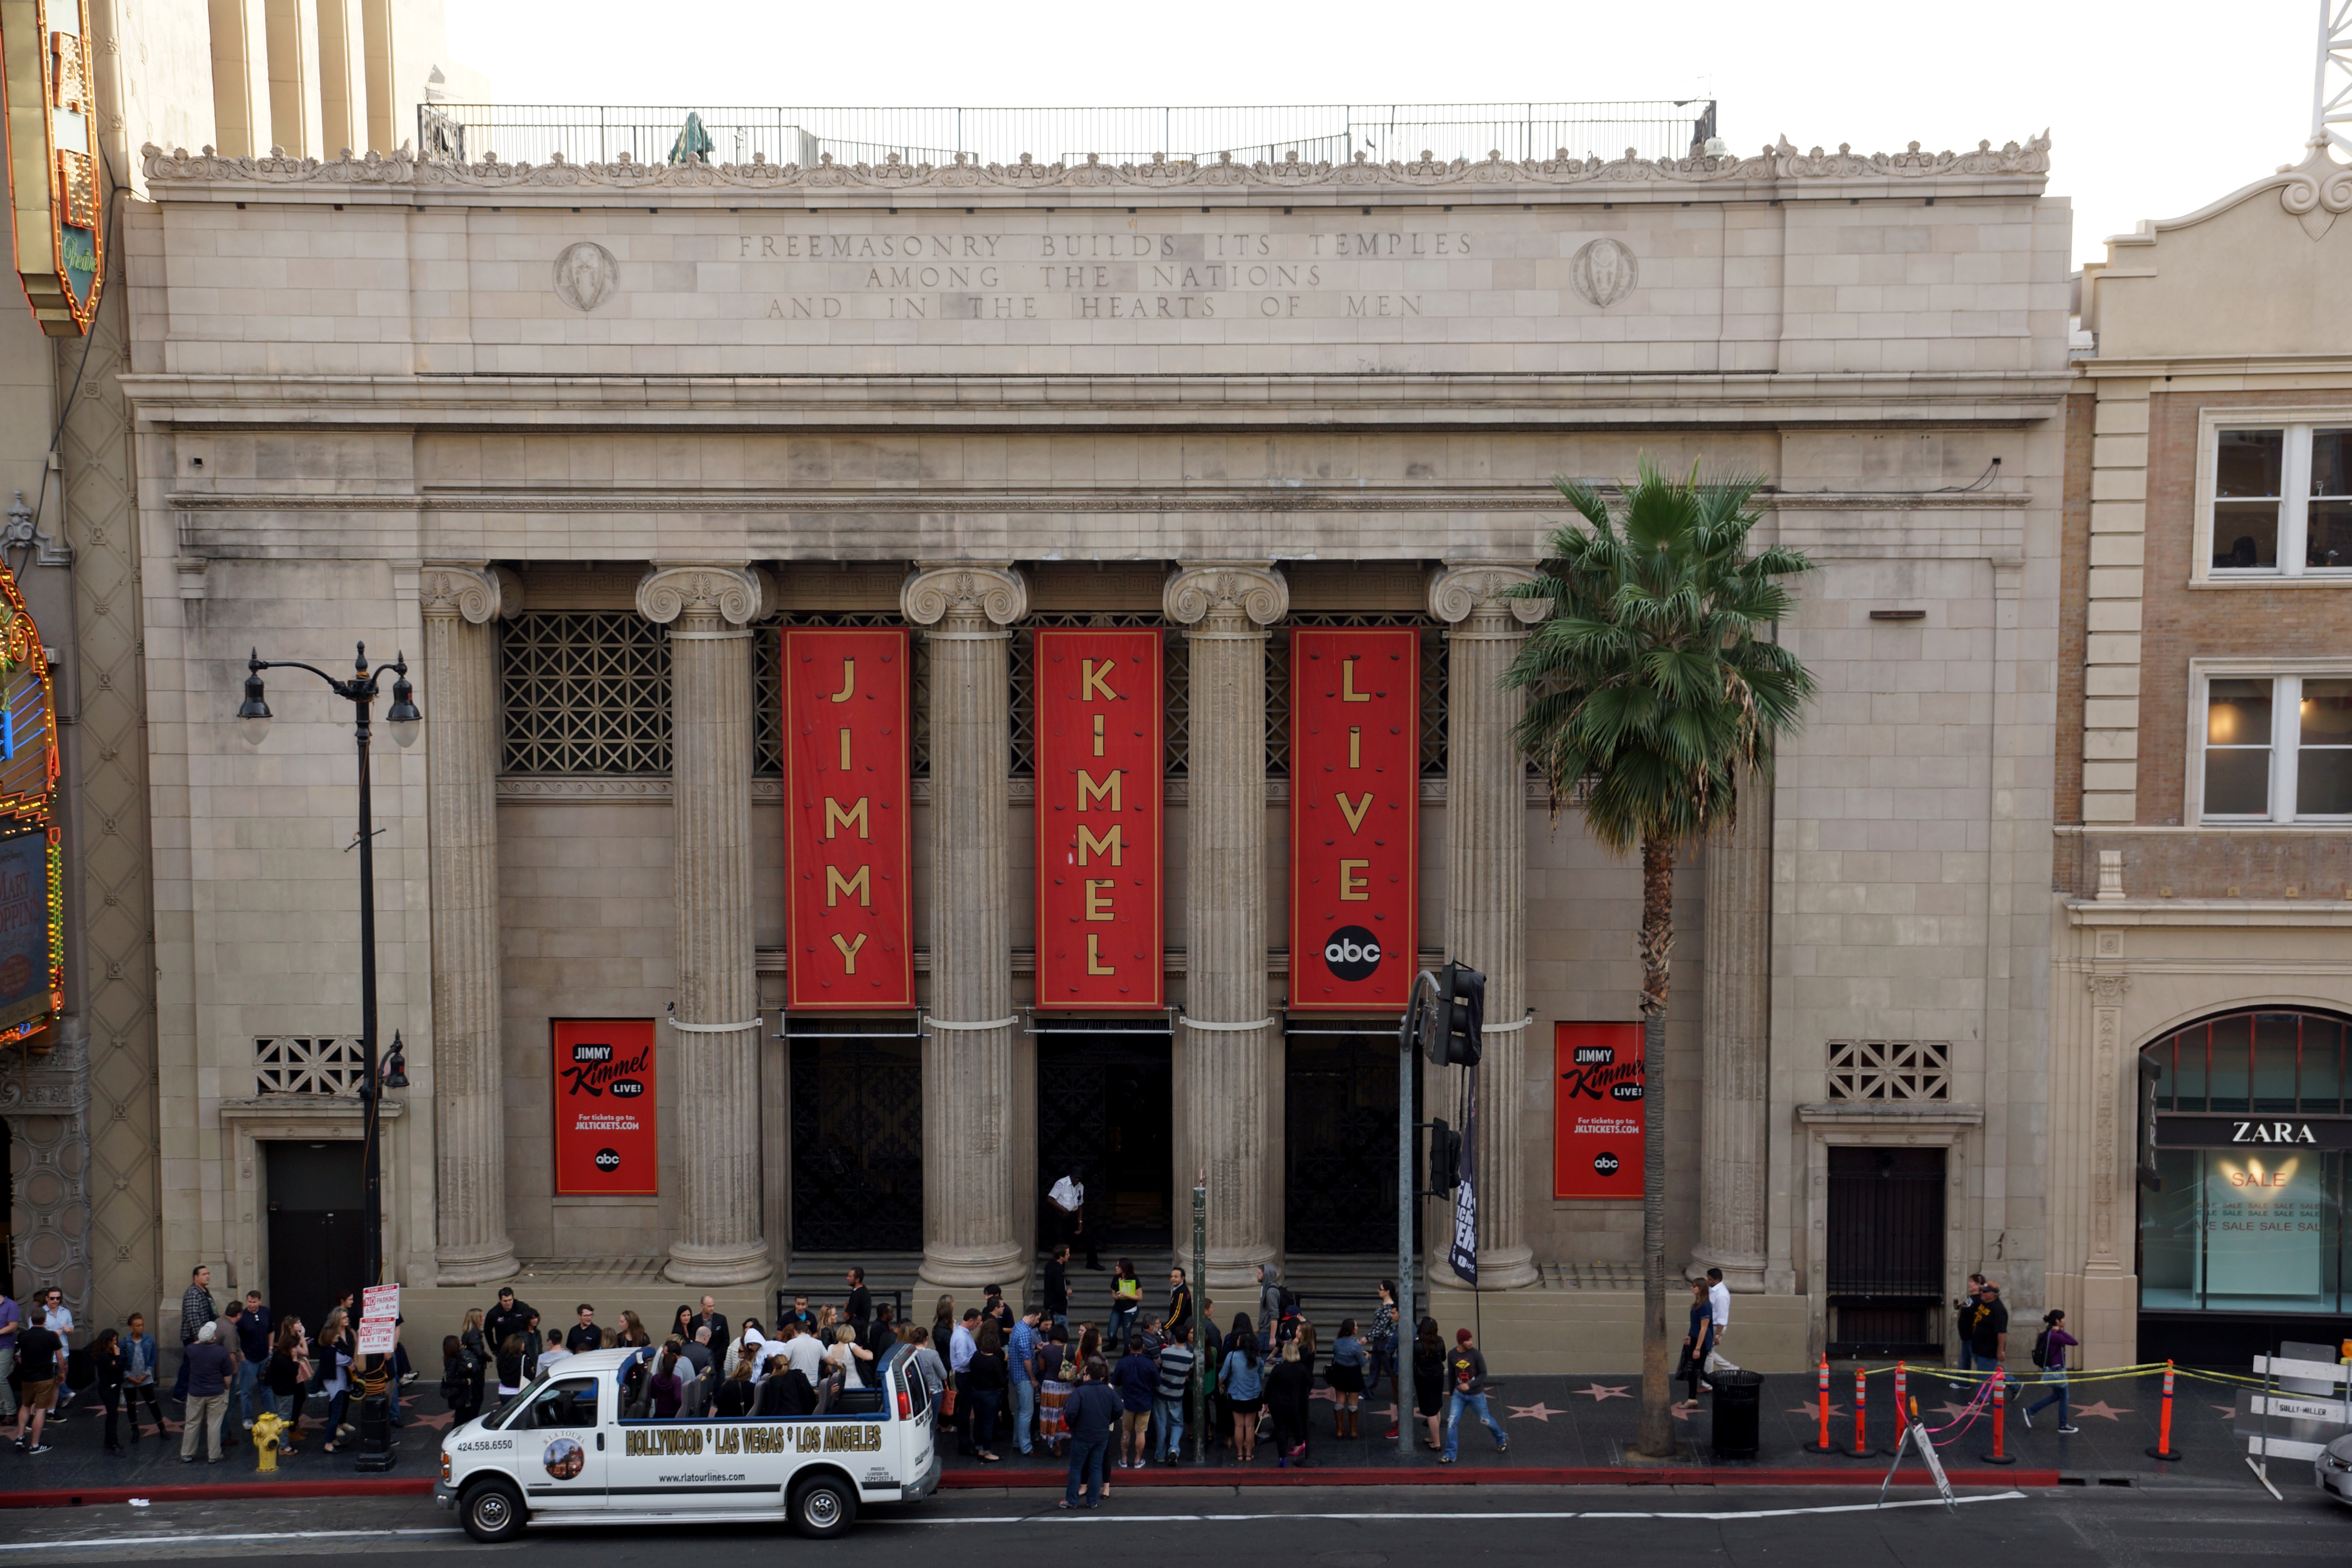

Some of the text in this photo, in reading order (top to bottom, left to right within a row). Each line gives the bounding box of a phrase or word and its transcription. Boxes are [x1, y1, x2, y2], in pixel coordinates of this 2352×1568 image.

[739, 233, 1471, 257] FREEMASONRY BUILDS ITS TEMPLES
[63, 236, 98, 272] Theatre
[865, 265, 1320, 288] AMONG THE NATIONS
[768, 296, 1422, 318] AND IN THE HEARTS OF MEN
[1334, 659, 1375, 901] LIVE
[824, 659, 871, 975] JIMMY
[1077, 658, 1122, 976] KIMMEL
[1325, 938, 1380, 962] abc
[575, 1047, 610, 1059] JIMMY
[1576, 1049, 1612, 1062] JIMMY
[561, 1045, 649, 1097] Kimmel
[614, 1084, 641, 1093] LIVE!
[1614, 1087, 1642, 1096] LIVE!
[575, 1122, 639, 1130] JKLTICKETS.COM
[1574, 1125, 1639, 1134] JKLTICKETS.COM
[2232, 1122, 2317, 1143] ZARA
[596, 1154, 620, 1164] abc
[1594, 1157, 1618, 1168] abc
[2232, 1172, 2286, 1187] SALE
[2222, 1221, 2254, 1230] SALE
[2260, 1222, 2292, 1231] SALE
[366, 1295, 397, 1306] NO PARKING
[361, 1327, 371, 1336] NO
[2279, 1405, 2327, 1416] SULLY-MILLER
[561, 1430, 586, 1444] TOURS
[626, 1425, 881, 1456] HOLLYWOOD LAS VEGAS LOS ANGELES
[457, 1440, 512, 1452] 424.558.6550
[659, 1472, 745, 1483] www.rlatourlines.com
